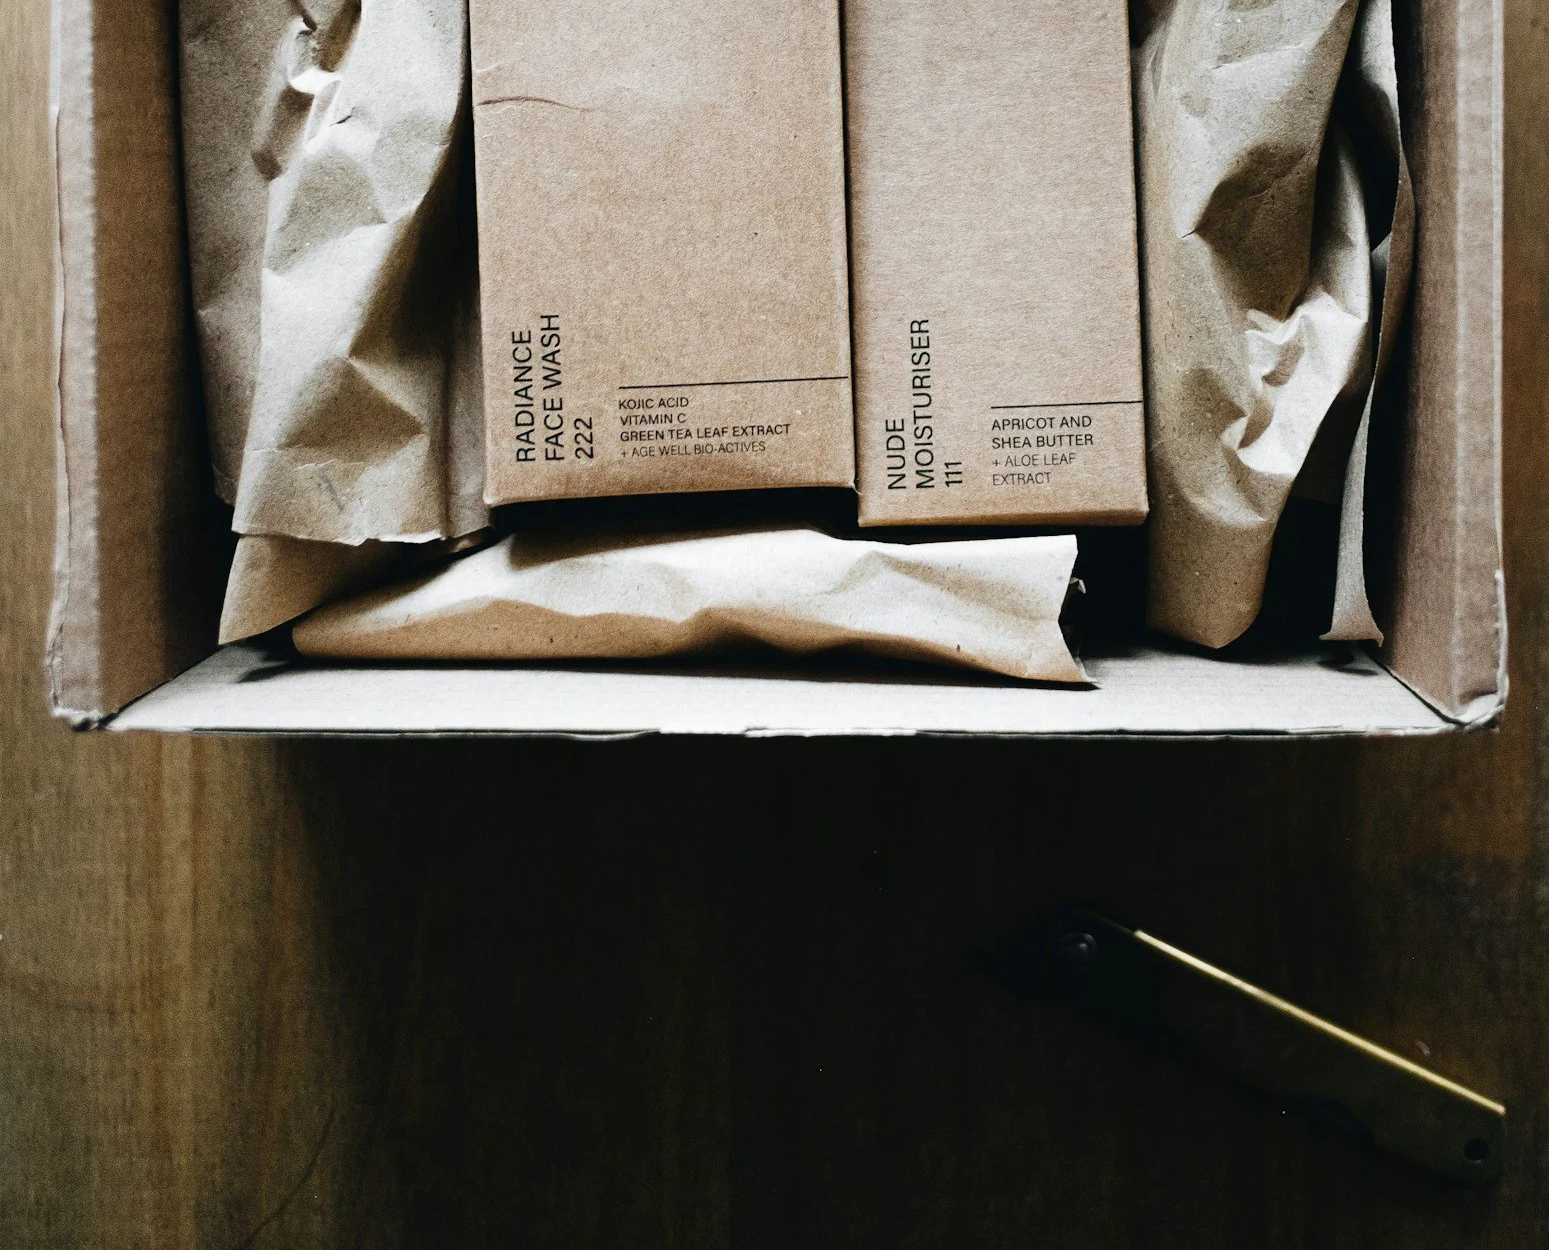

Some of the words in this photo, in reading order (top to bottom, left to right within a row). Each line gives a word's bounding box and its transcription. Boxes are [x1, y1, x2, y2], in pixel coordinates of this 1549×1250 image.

[540, 314, 562, 391] WASH
[511, 330, 536, 462] RADIANCE
[618, 398, 655, 410] KOJIC
[658, 396, 689, 408] ACID
[910, 319, 935, 489] MOISTURISER
[620, 414, 673, 426] VITAMIN
[677, 412, 687, 424] C
[991, 417, 1055, 431] APRICOT
[1060, 415, 1092, 428] AND
[543, 398, 565, 461] FACE
[574, 417, 594, 459] 222
[620, 429, 664, 442] GREEN
[668, 428, 692, 440] TEA
[696, 426, 729, 439] LEAF
[732, 423, 791, 437] EXTRACT
[631, 446, 655, 458] AGE
[658, 444, 691, 456] WELL
[693, 441, 766, 455] BIO-ACTIVES
[992, 436, 1032, 449] SHEA
[1036, 434, 1093, 448] BUTTER
[885, 418, 907, 490] NUDE
[1005, 454, 1039, 467] ALOE
[1044, 453, 1076, 466] LEAF
[944, 461, 963, 488] 111
[992, 472, 1052, 486] EXTRACT
